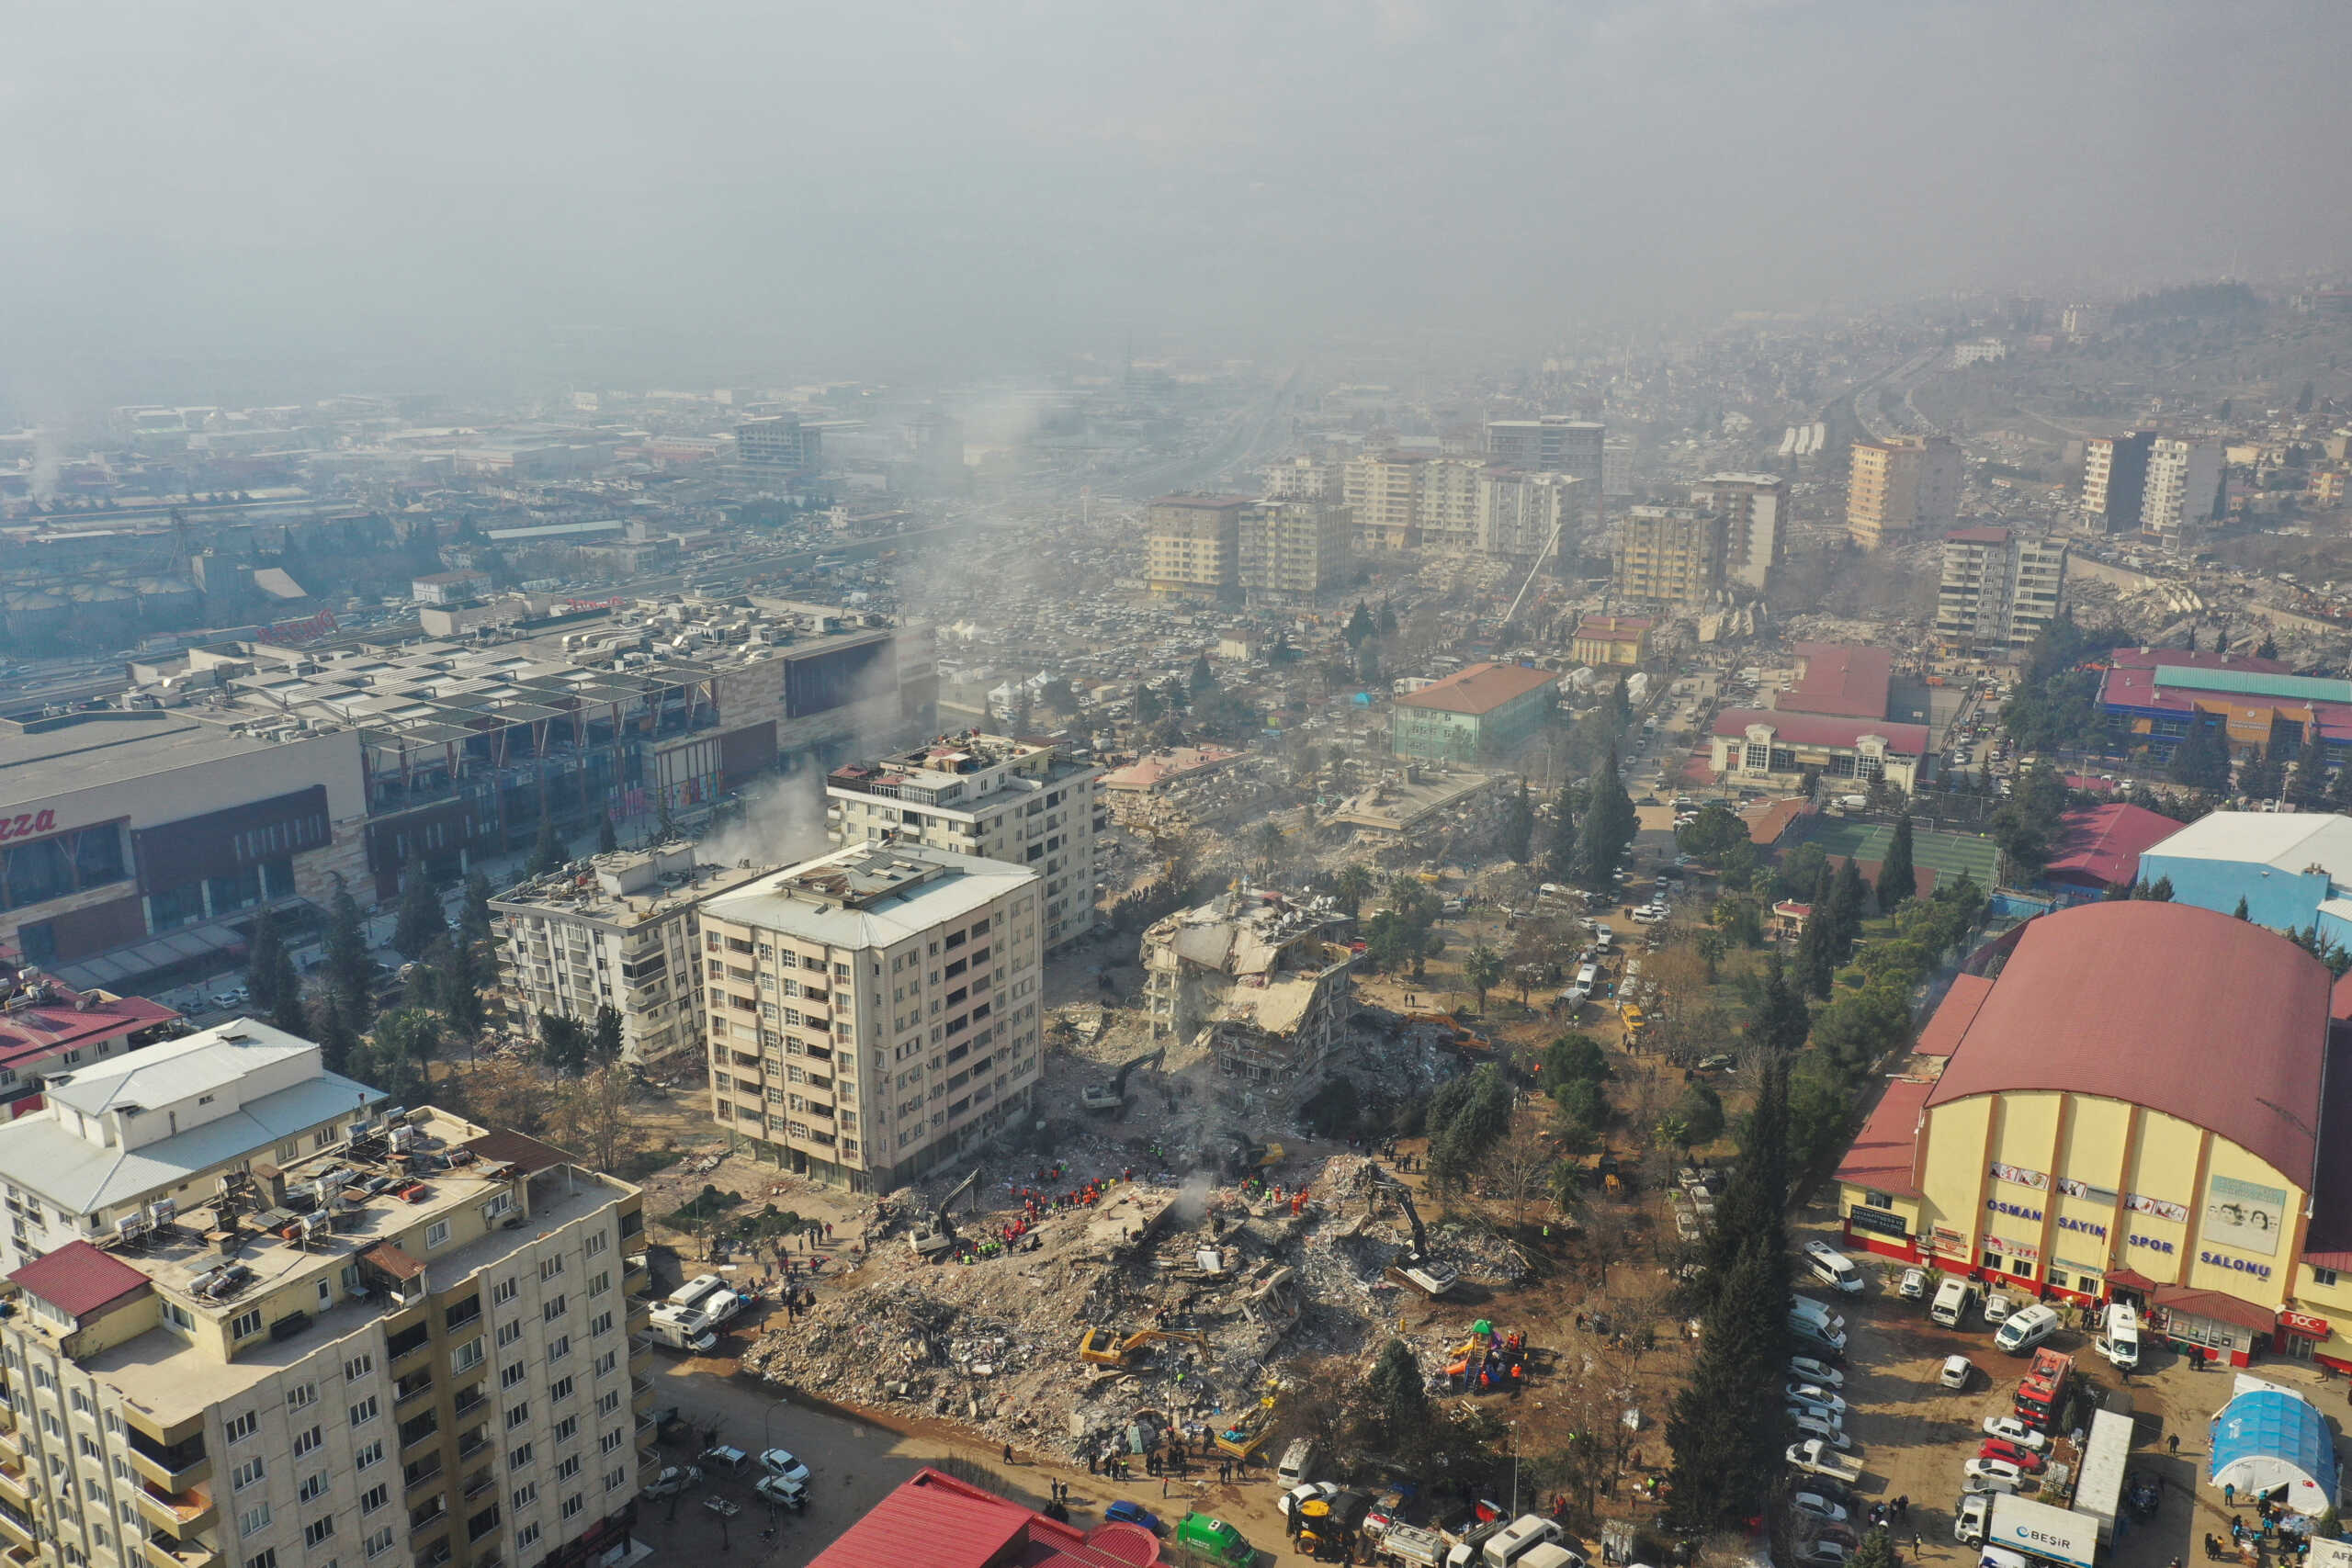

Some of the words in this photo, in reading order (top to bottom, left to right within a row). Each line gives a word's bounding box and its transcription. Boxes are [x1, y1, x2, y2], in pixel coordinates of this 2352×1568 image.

[1987, 1199, 2042, 1221] OSMAN
[2058, 1216, 2105, 1237] SAYIN
[2129, 1235, 2174, 1255] SPOR
[2200, 1251, 2271, 1278] SALONU
